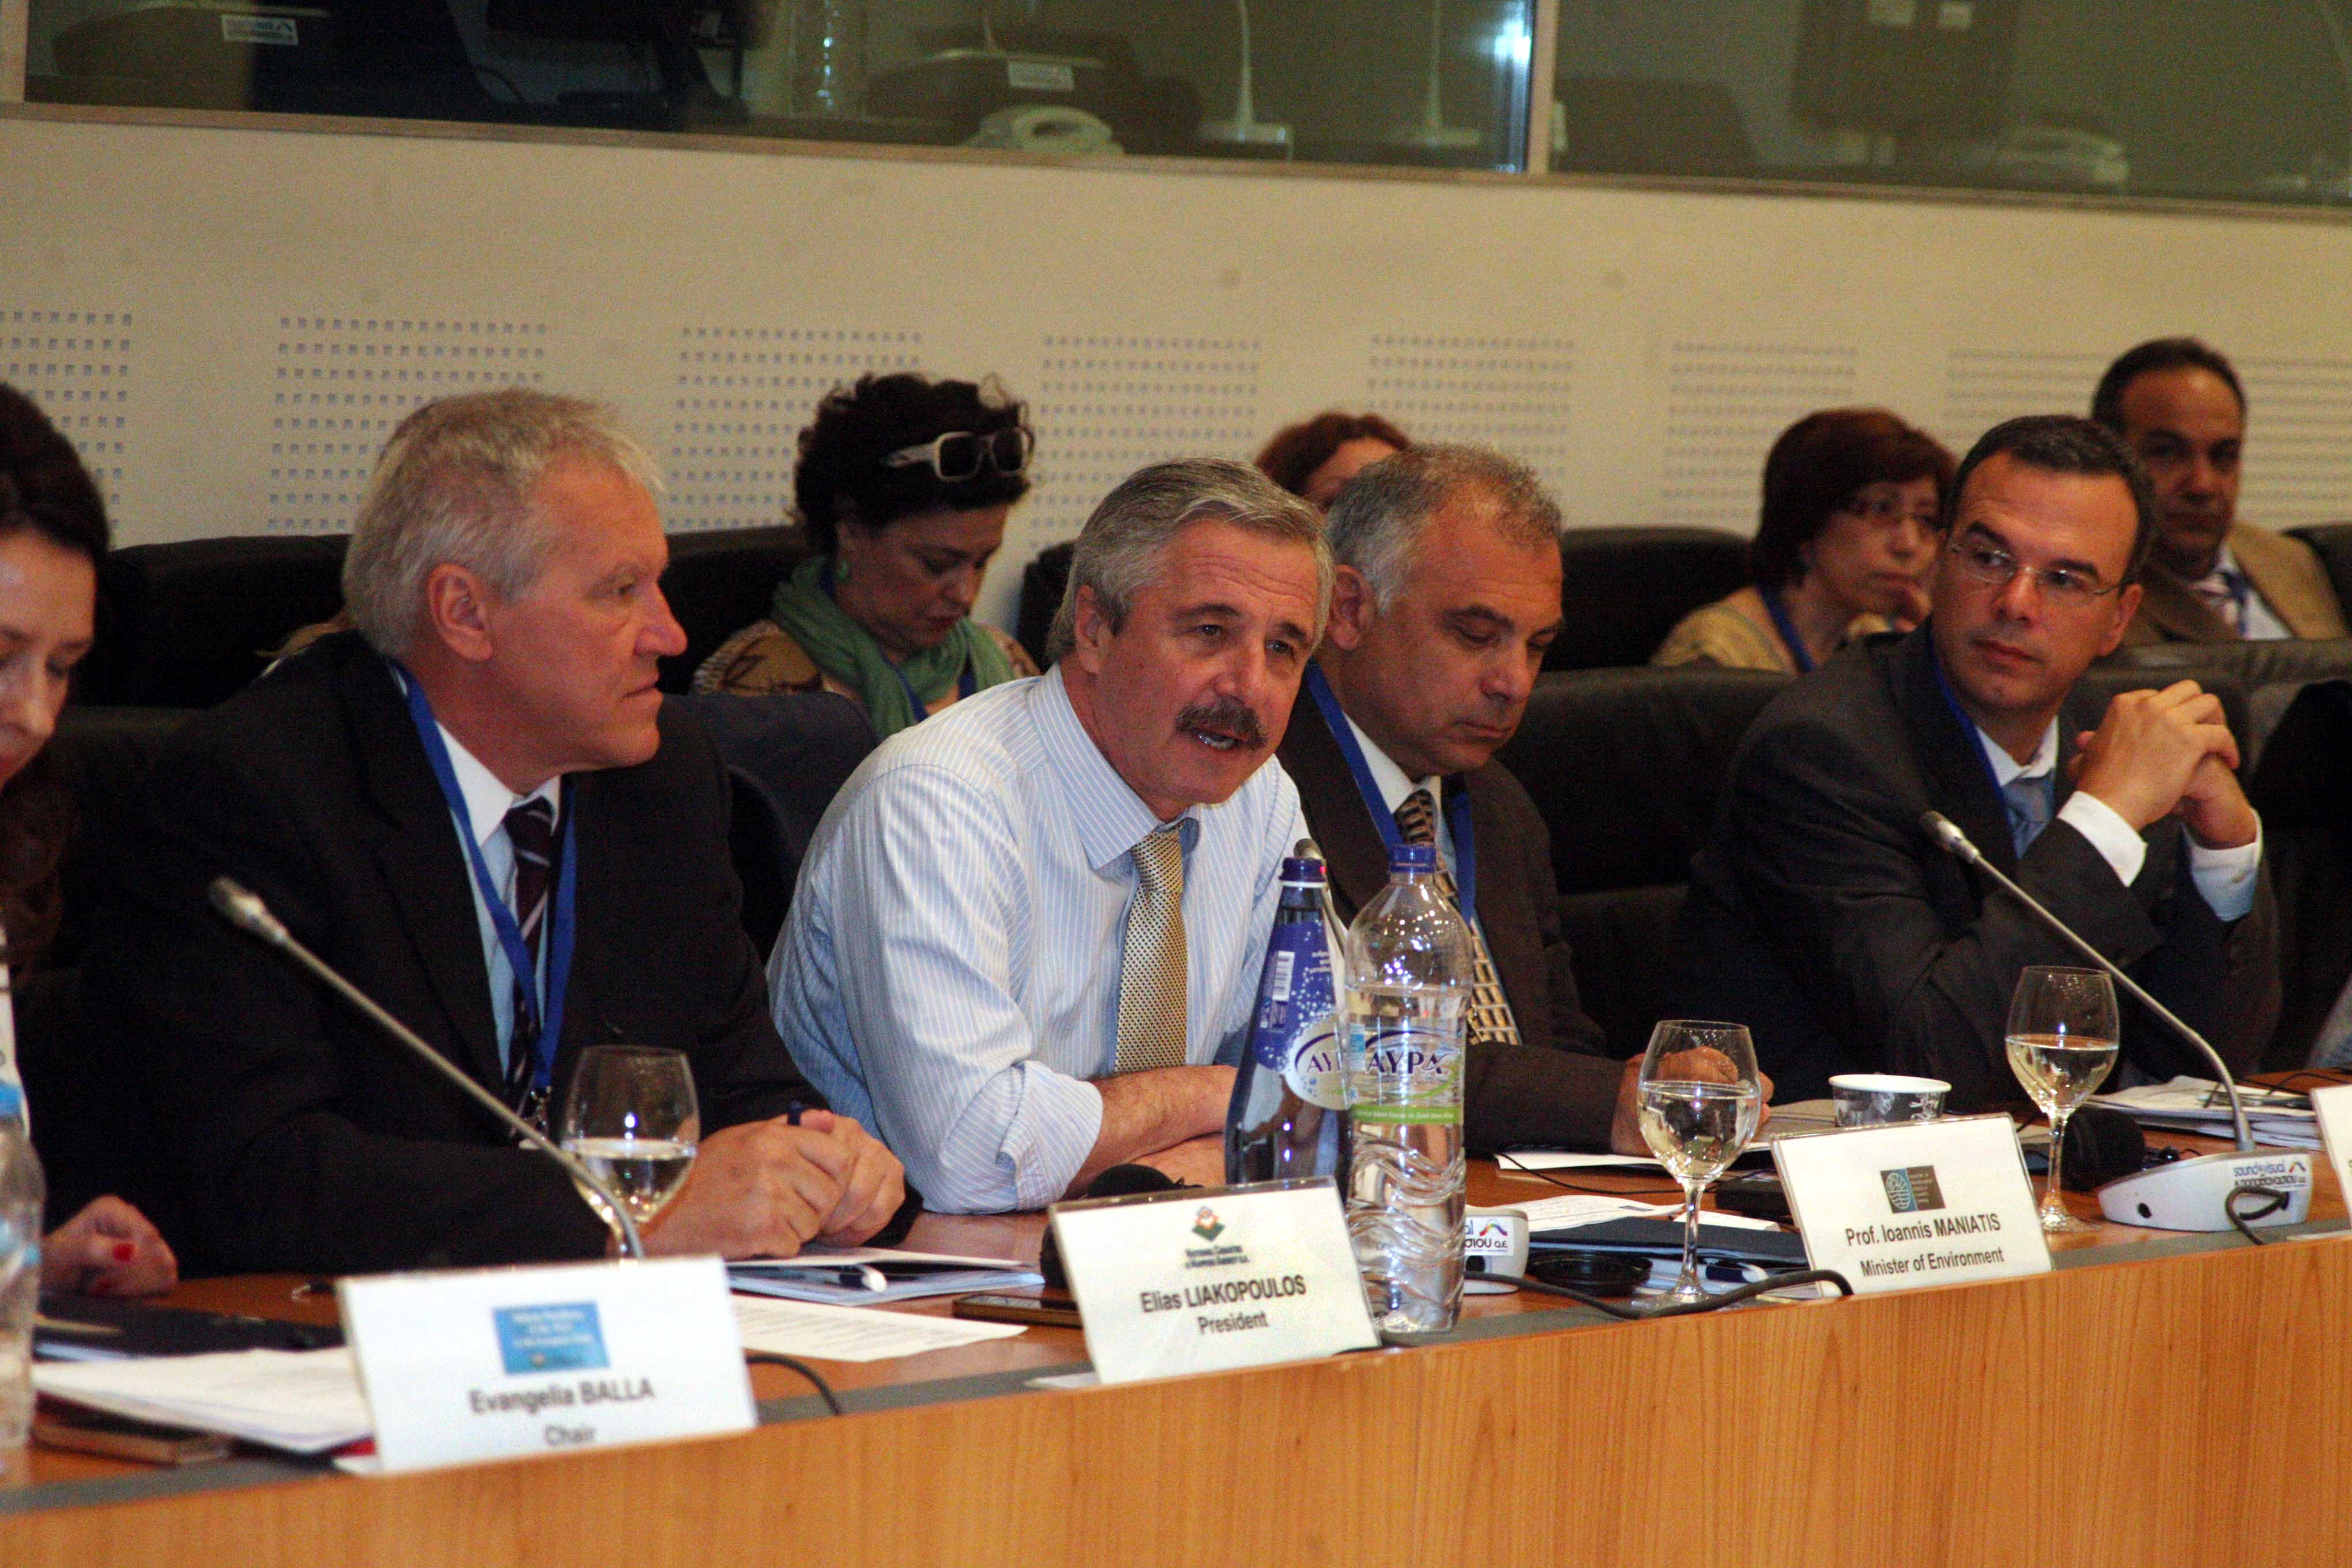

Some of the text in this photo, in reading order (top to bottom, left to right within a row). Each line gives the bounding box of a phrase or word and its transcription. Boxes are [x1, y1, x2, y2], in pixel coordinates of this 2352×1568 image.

[1846, 1212, 2002, 1247] Prof. Ioannis MANIATIS
[1860, 1246, 2005, 1277] Minister of Environment
[1140, 1275, 1307, 1313] Elias LIAKOPOULOS
[1197, 1312, 1268, 1335] President
[468, 1378, 655, 1415] Evangelia BALLA
[545, 1424, 596, 1446] Chair
